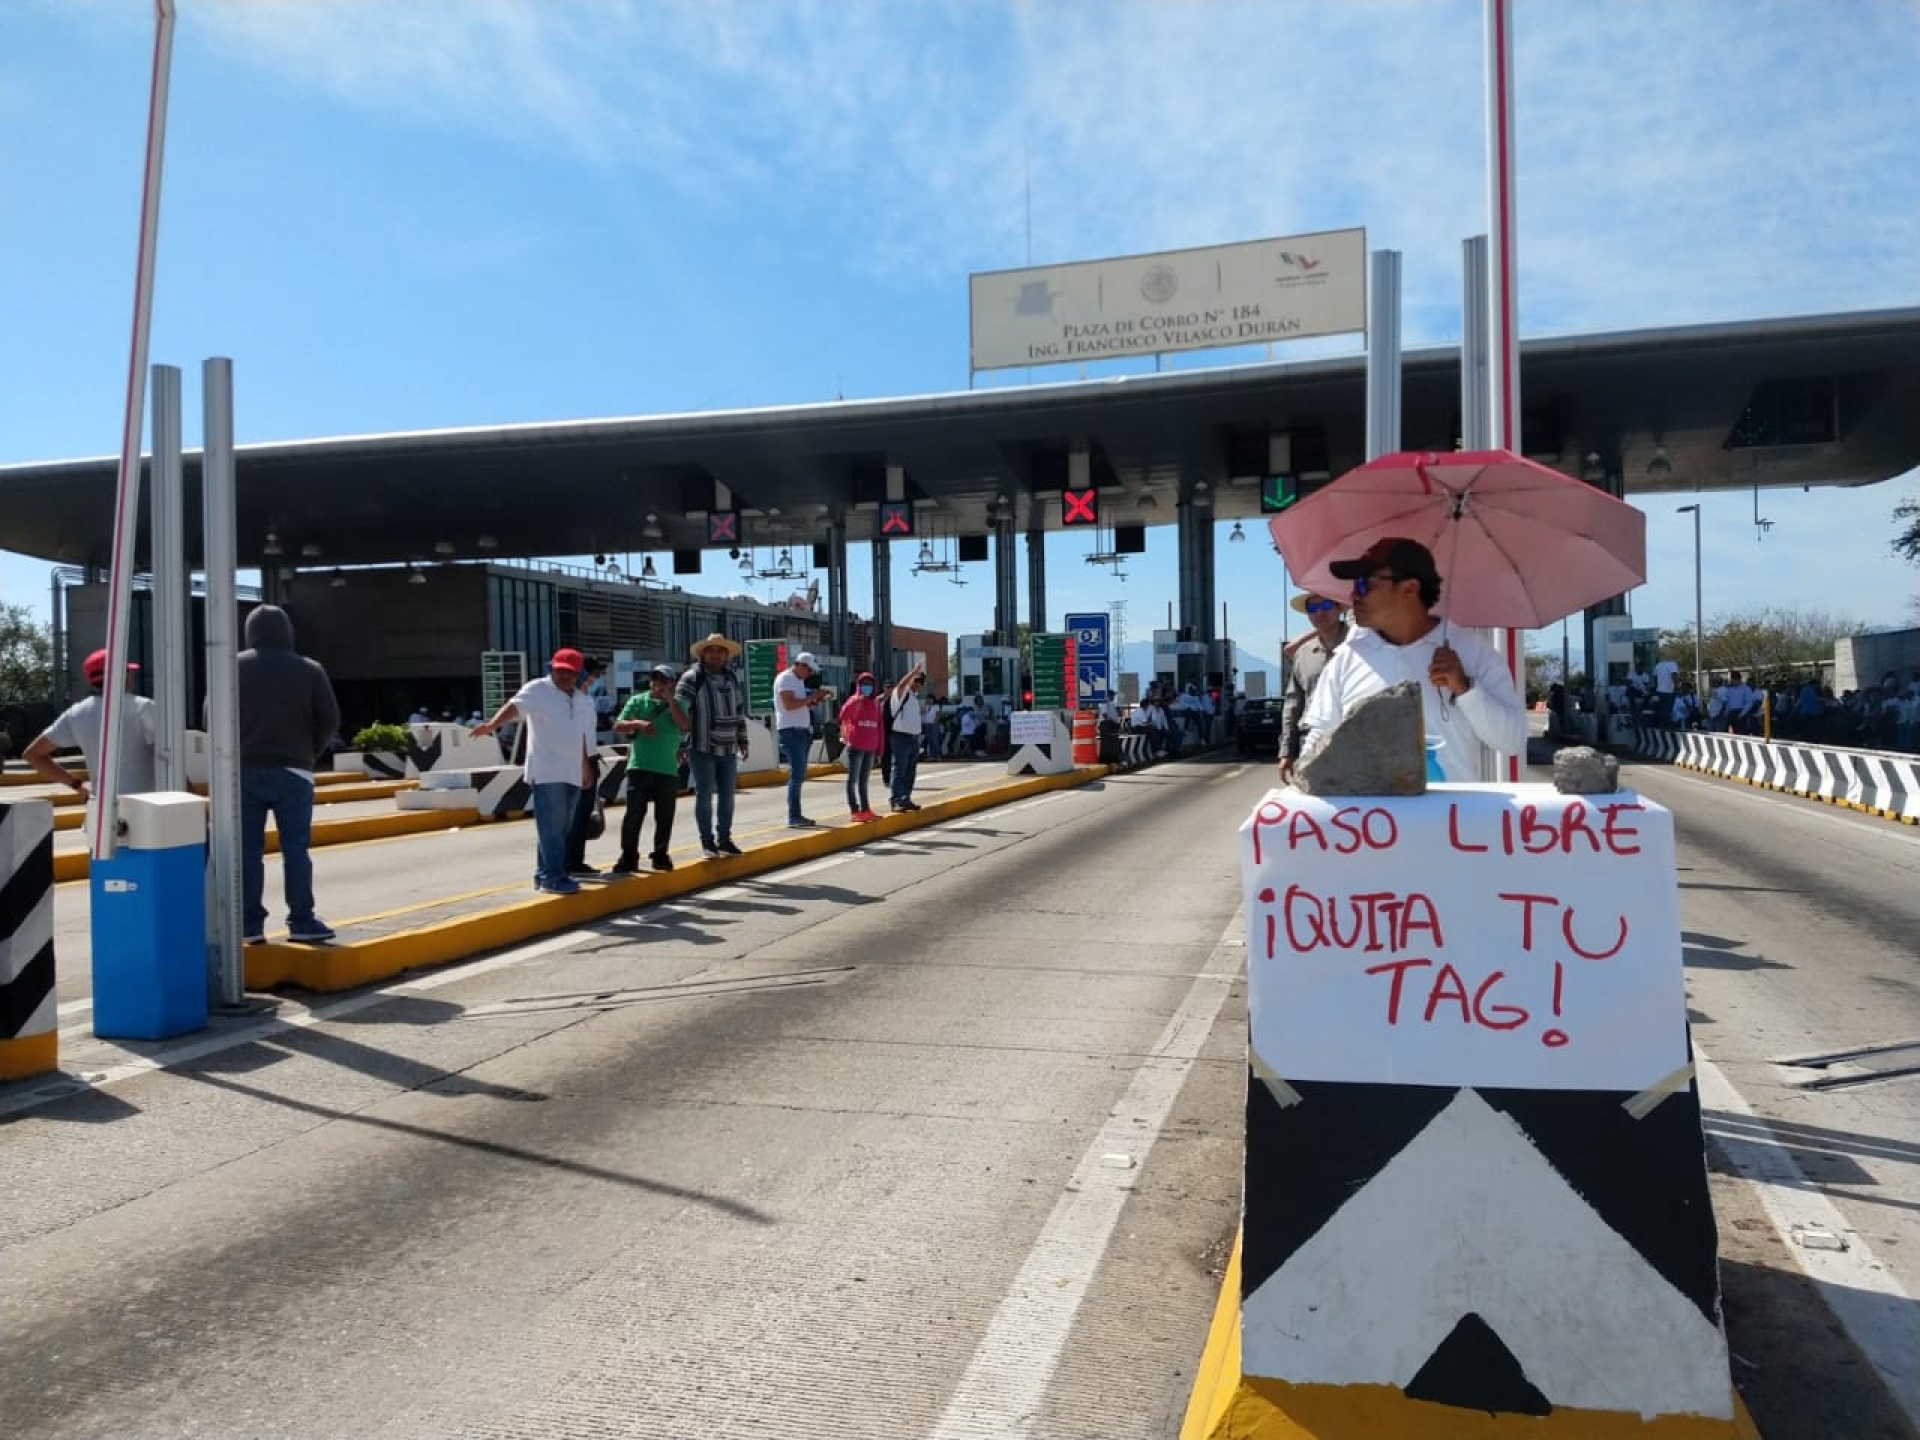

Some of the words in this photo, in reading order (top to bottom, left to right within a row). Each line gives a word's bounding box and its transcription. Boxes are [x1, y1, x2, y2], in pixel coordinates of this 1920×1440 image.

[1062, 322, 1109, 338] PLAZA
[1115, 319, 1134, 334] DE
[1140, 312, 1199, 331] COBRO
[1232, 302, 1260, 321] 184
[1067, 333, 1157, 354] FRANCISCO
[1163, 325, 1234, 344] VELASCO
[1252, 801, 1398, 864] PASO
[1449, 800, 1646, 855] LIBRE
[1499, 893, 1628, 960] TU
[1364, 958, 1569, 1047] TAG!
